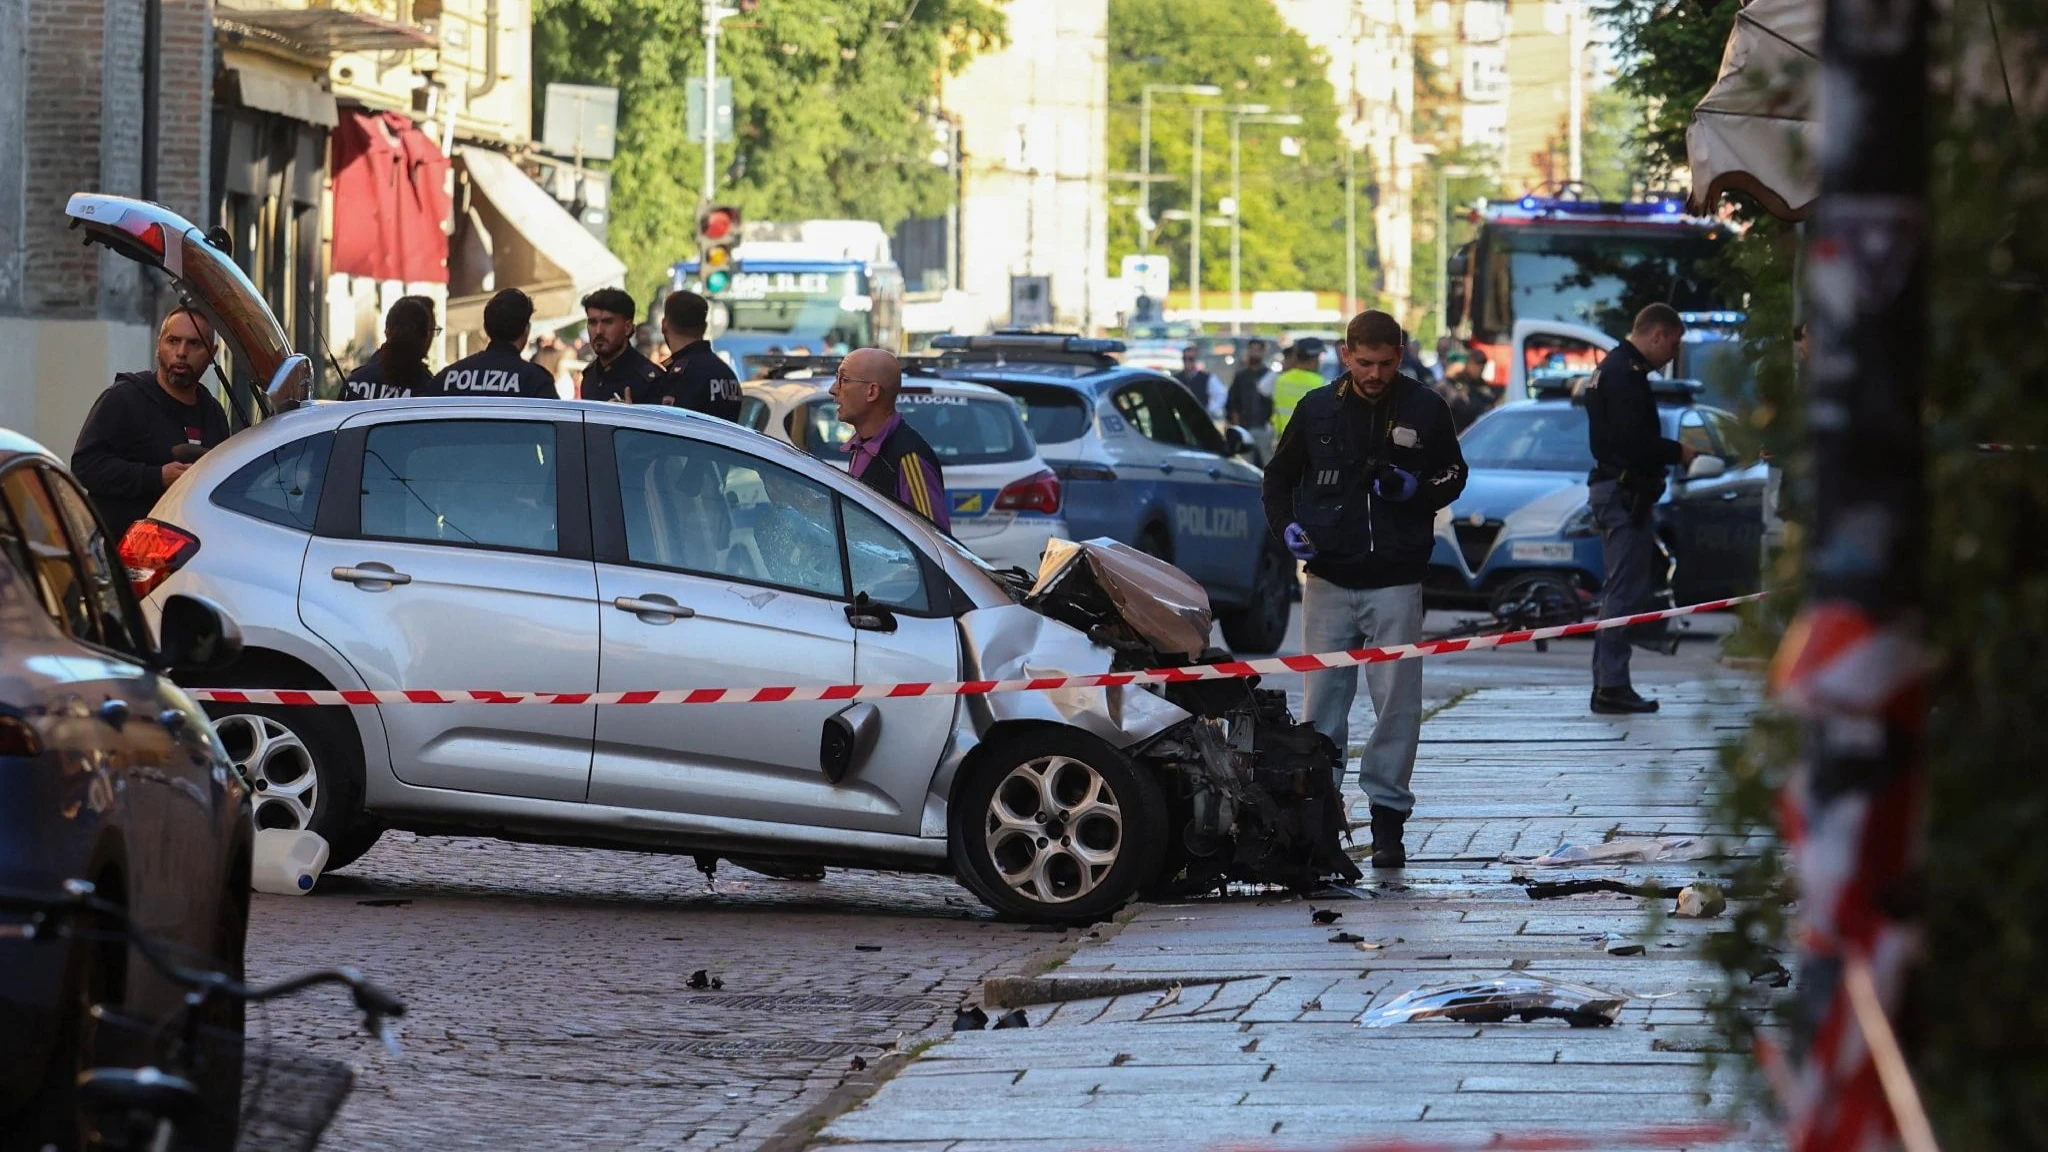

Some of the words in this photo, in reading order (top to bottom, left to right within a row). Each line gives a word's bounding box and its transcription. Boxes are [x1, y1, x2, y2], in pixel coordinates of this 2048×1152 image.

[444, 370, 520, 392] POLIZIA
[914, 395, 968, 406] LOCALE
[1176, 504, 1248, 539] POLIZIA
